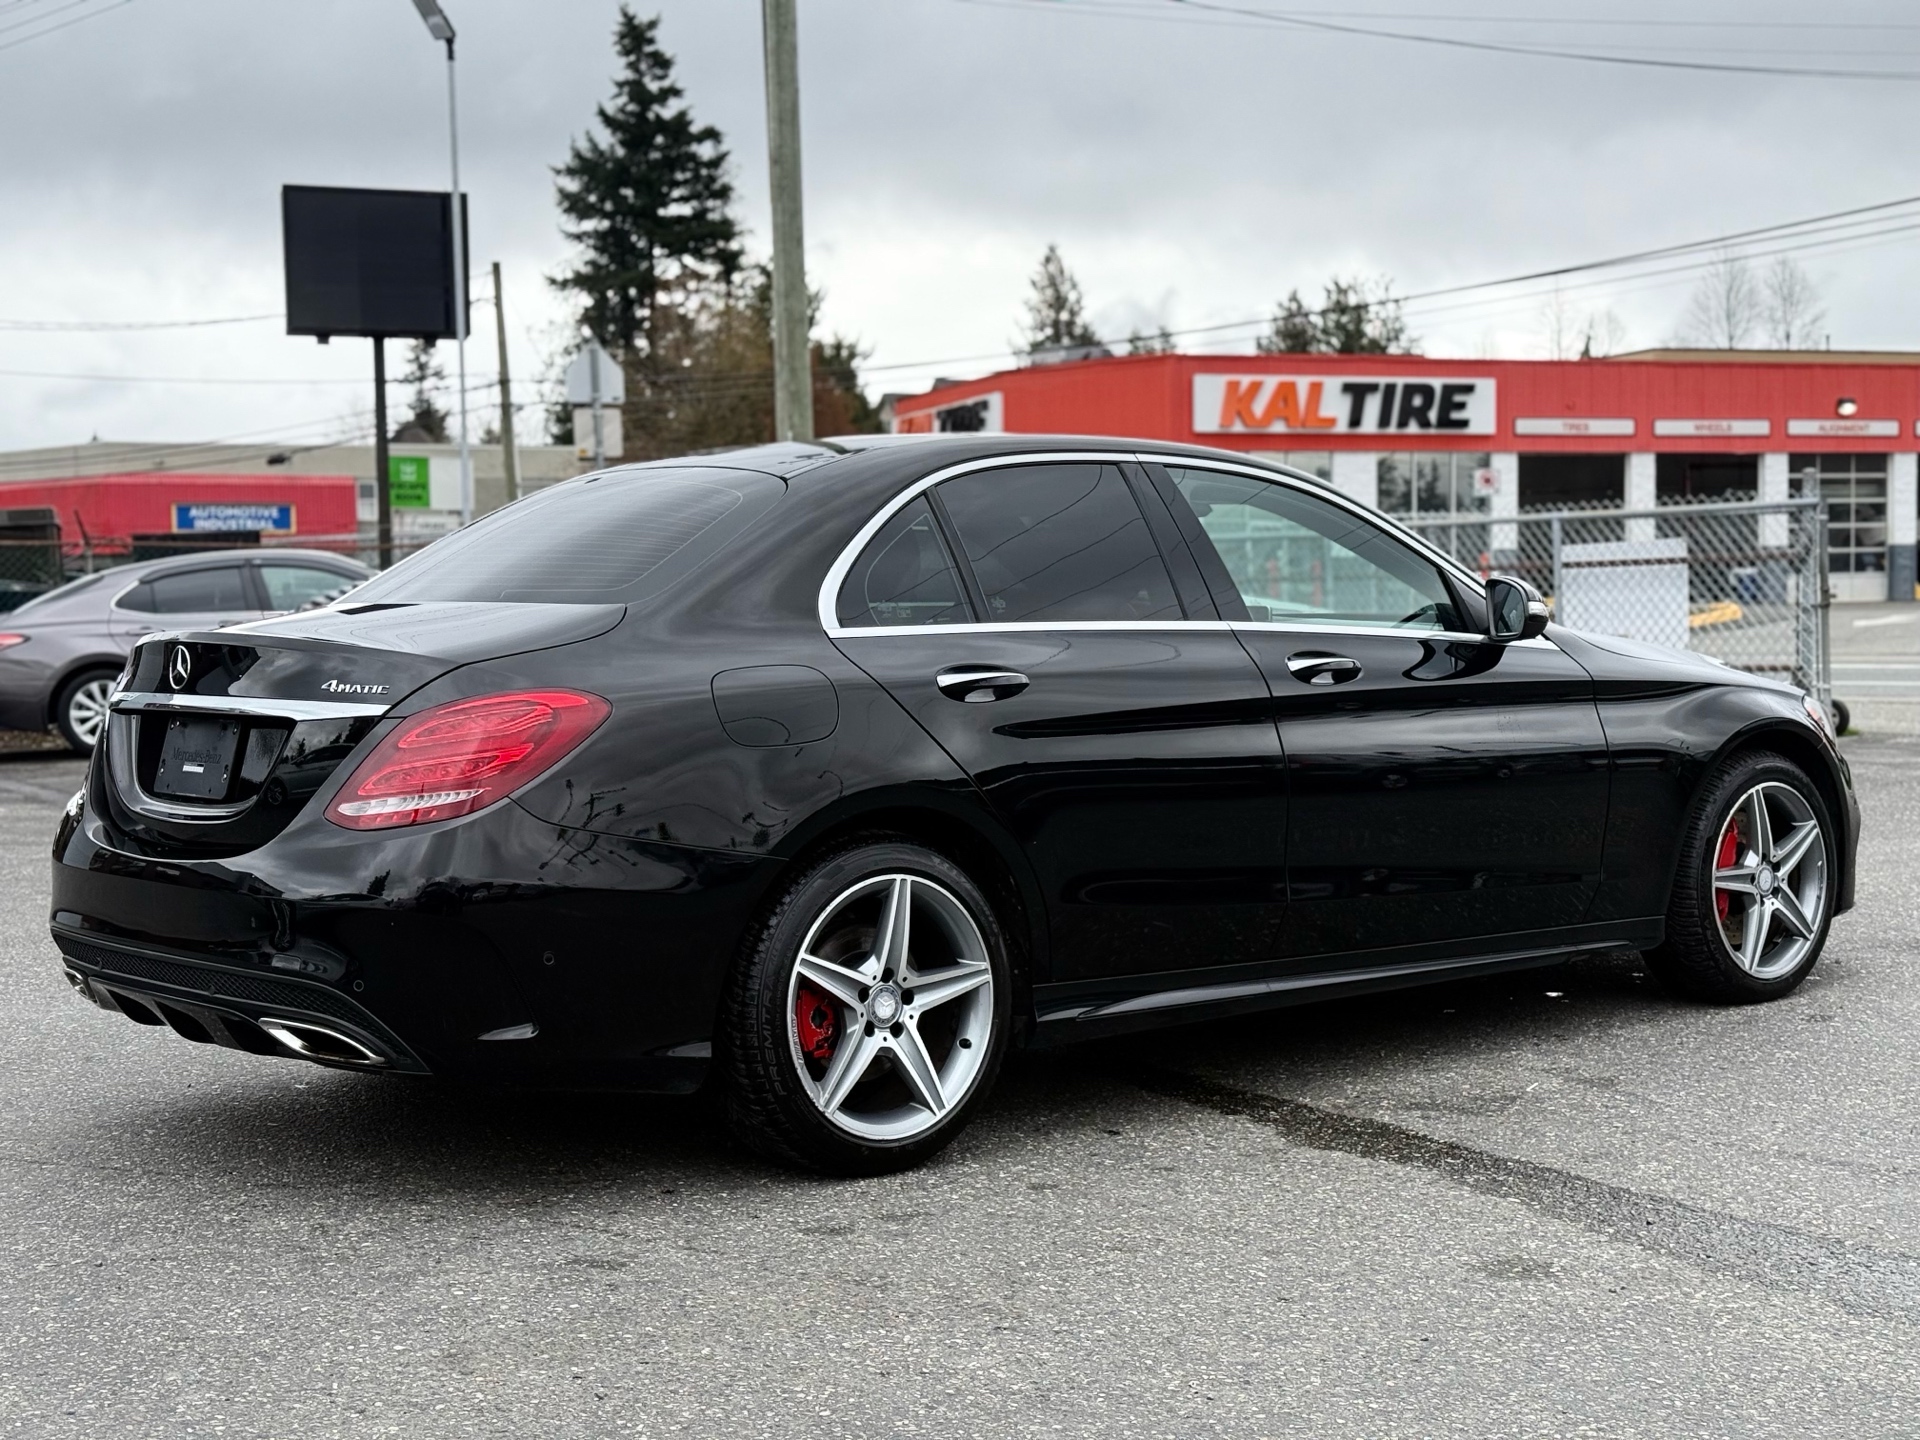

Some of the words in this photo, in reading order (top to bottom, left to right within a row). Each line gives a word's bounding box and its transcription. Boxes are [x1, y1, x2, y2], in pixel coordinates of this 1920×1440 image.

[1219, 380, 1337, 428] KAL
[1341, 382, 1476, 429] TIRE
[1562, 423, 1590, 433] TIRES
[1694, 423, 1733, 433] WHEELS
[1818, 423, 1871, 434] ALIGNMENT
[188, 504, 280, 519] AUTOMOTIVE
[193, 518, 275, 531] INDUSTRIAL
[321, 679, 390, 695] 4MATIC
